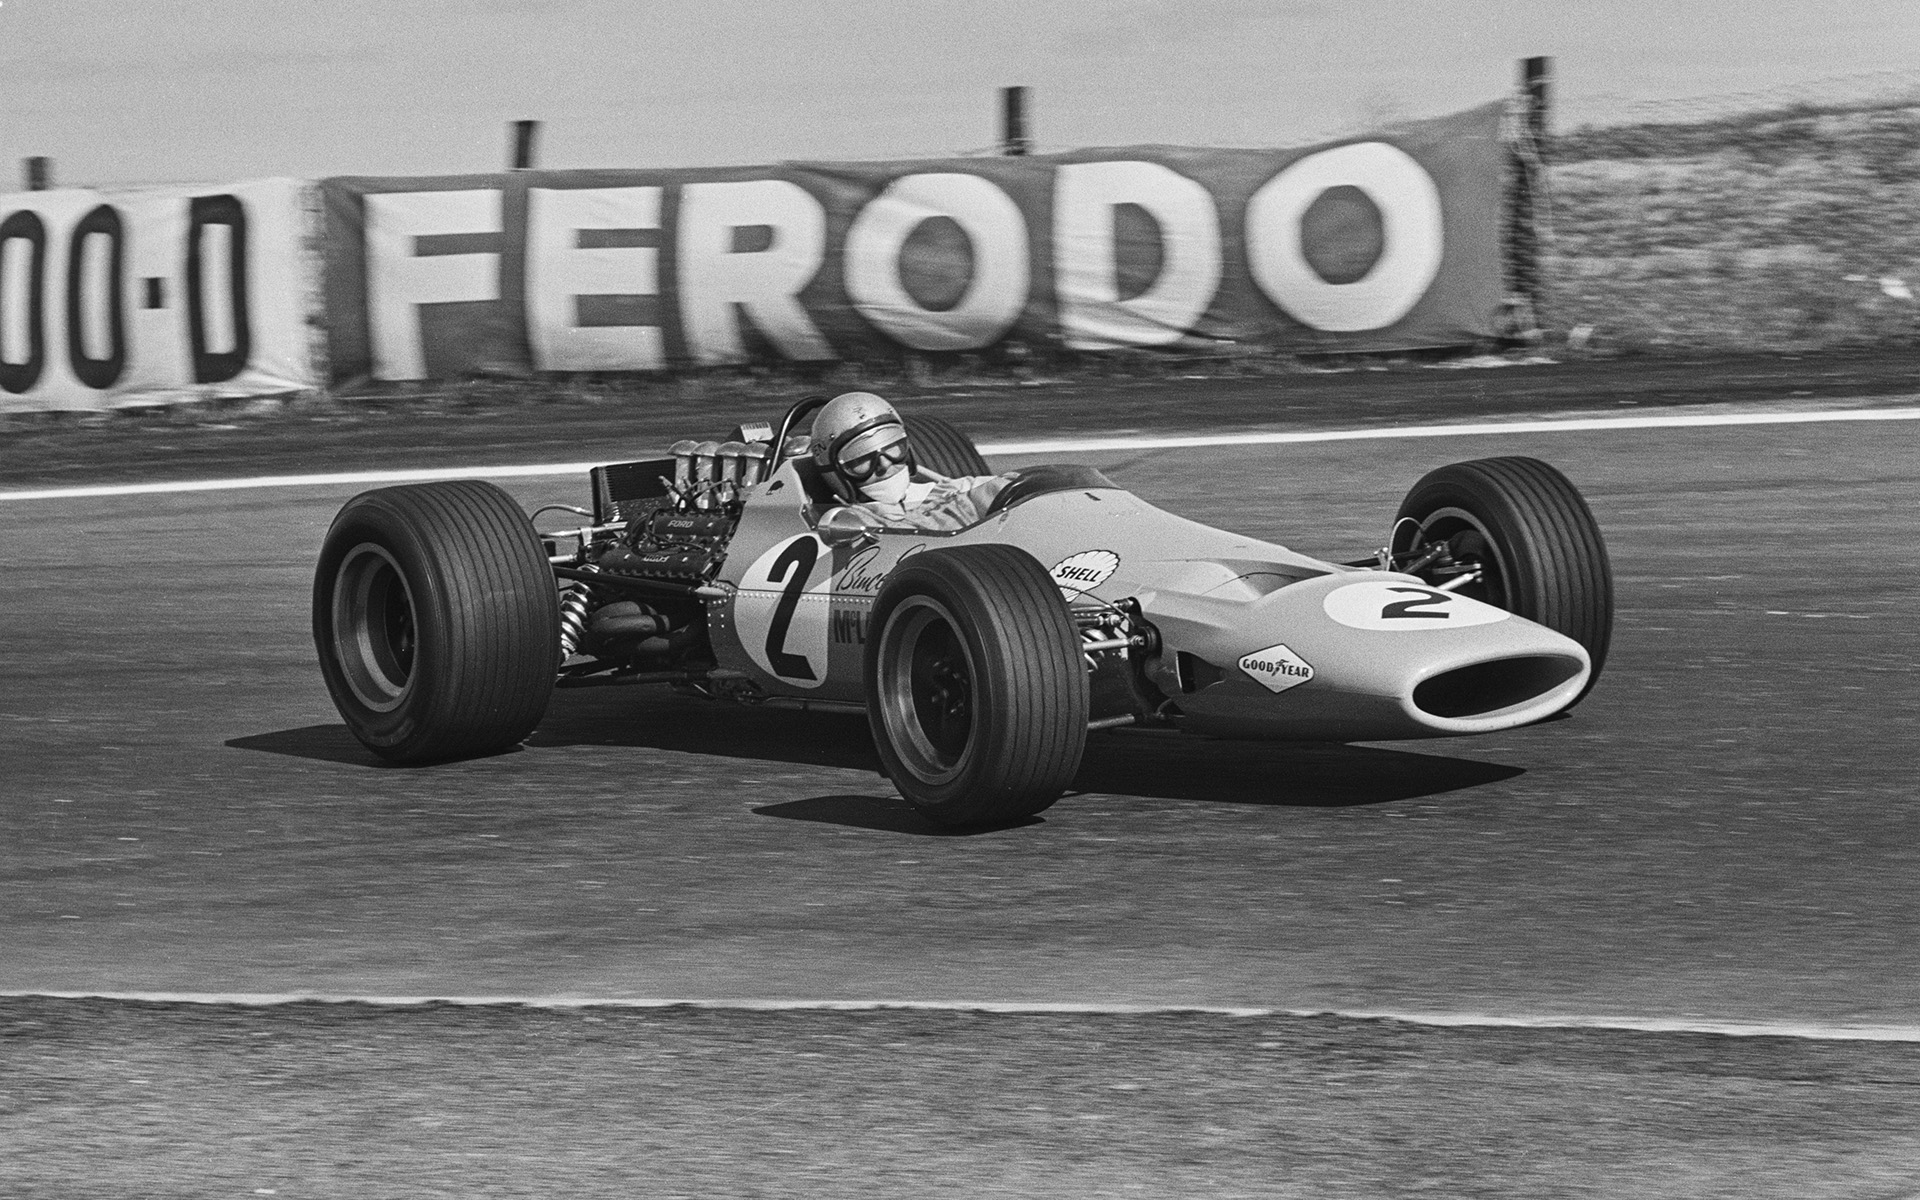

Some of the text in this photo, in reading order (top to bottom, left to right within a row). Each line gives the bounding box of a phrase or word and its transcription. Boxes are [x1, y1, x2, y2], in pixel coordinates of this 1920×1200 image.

[362, 141, 1444, 381] FERODO
[667, 519, 694, 529] FORD
[1056, 565, 1102, 582] SHELL
[765, 535, 818, 681] 2
[1381, 587, 1453, 619] 2
